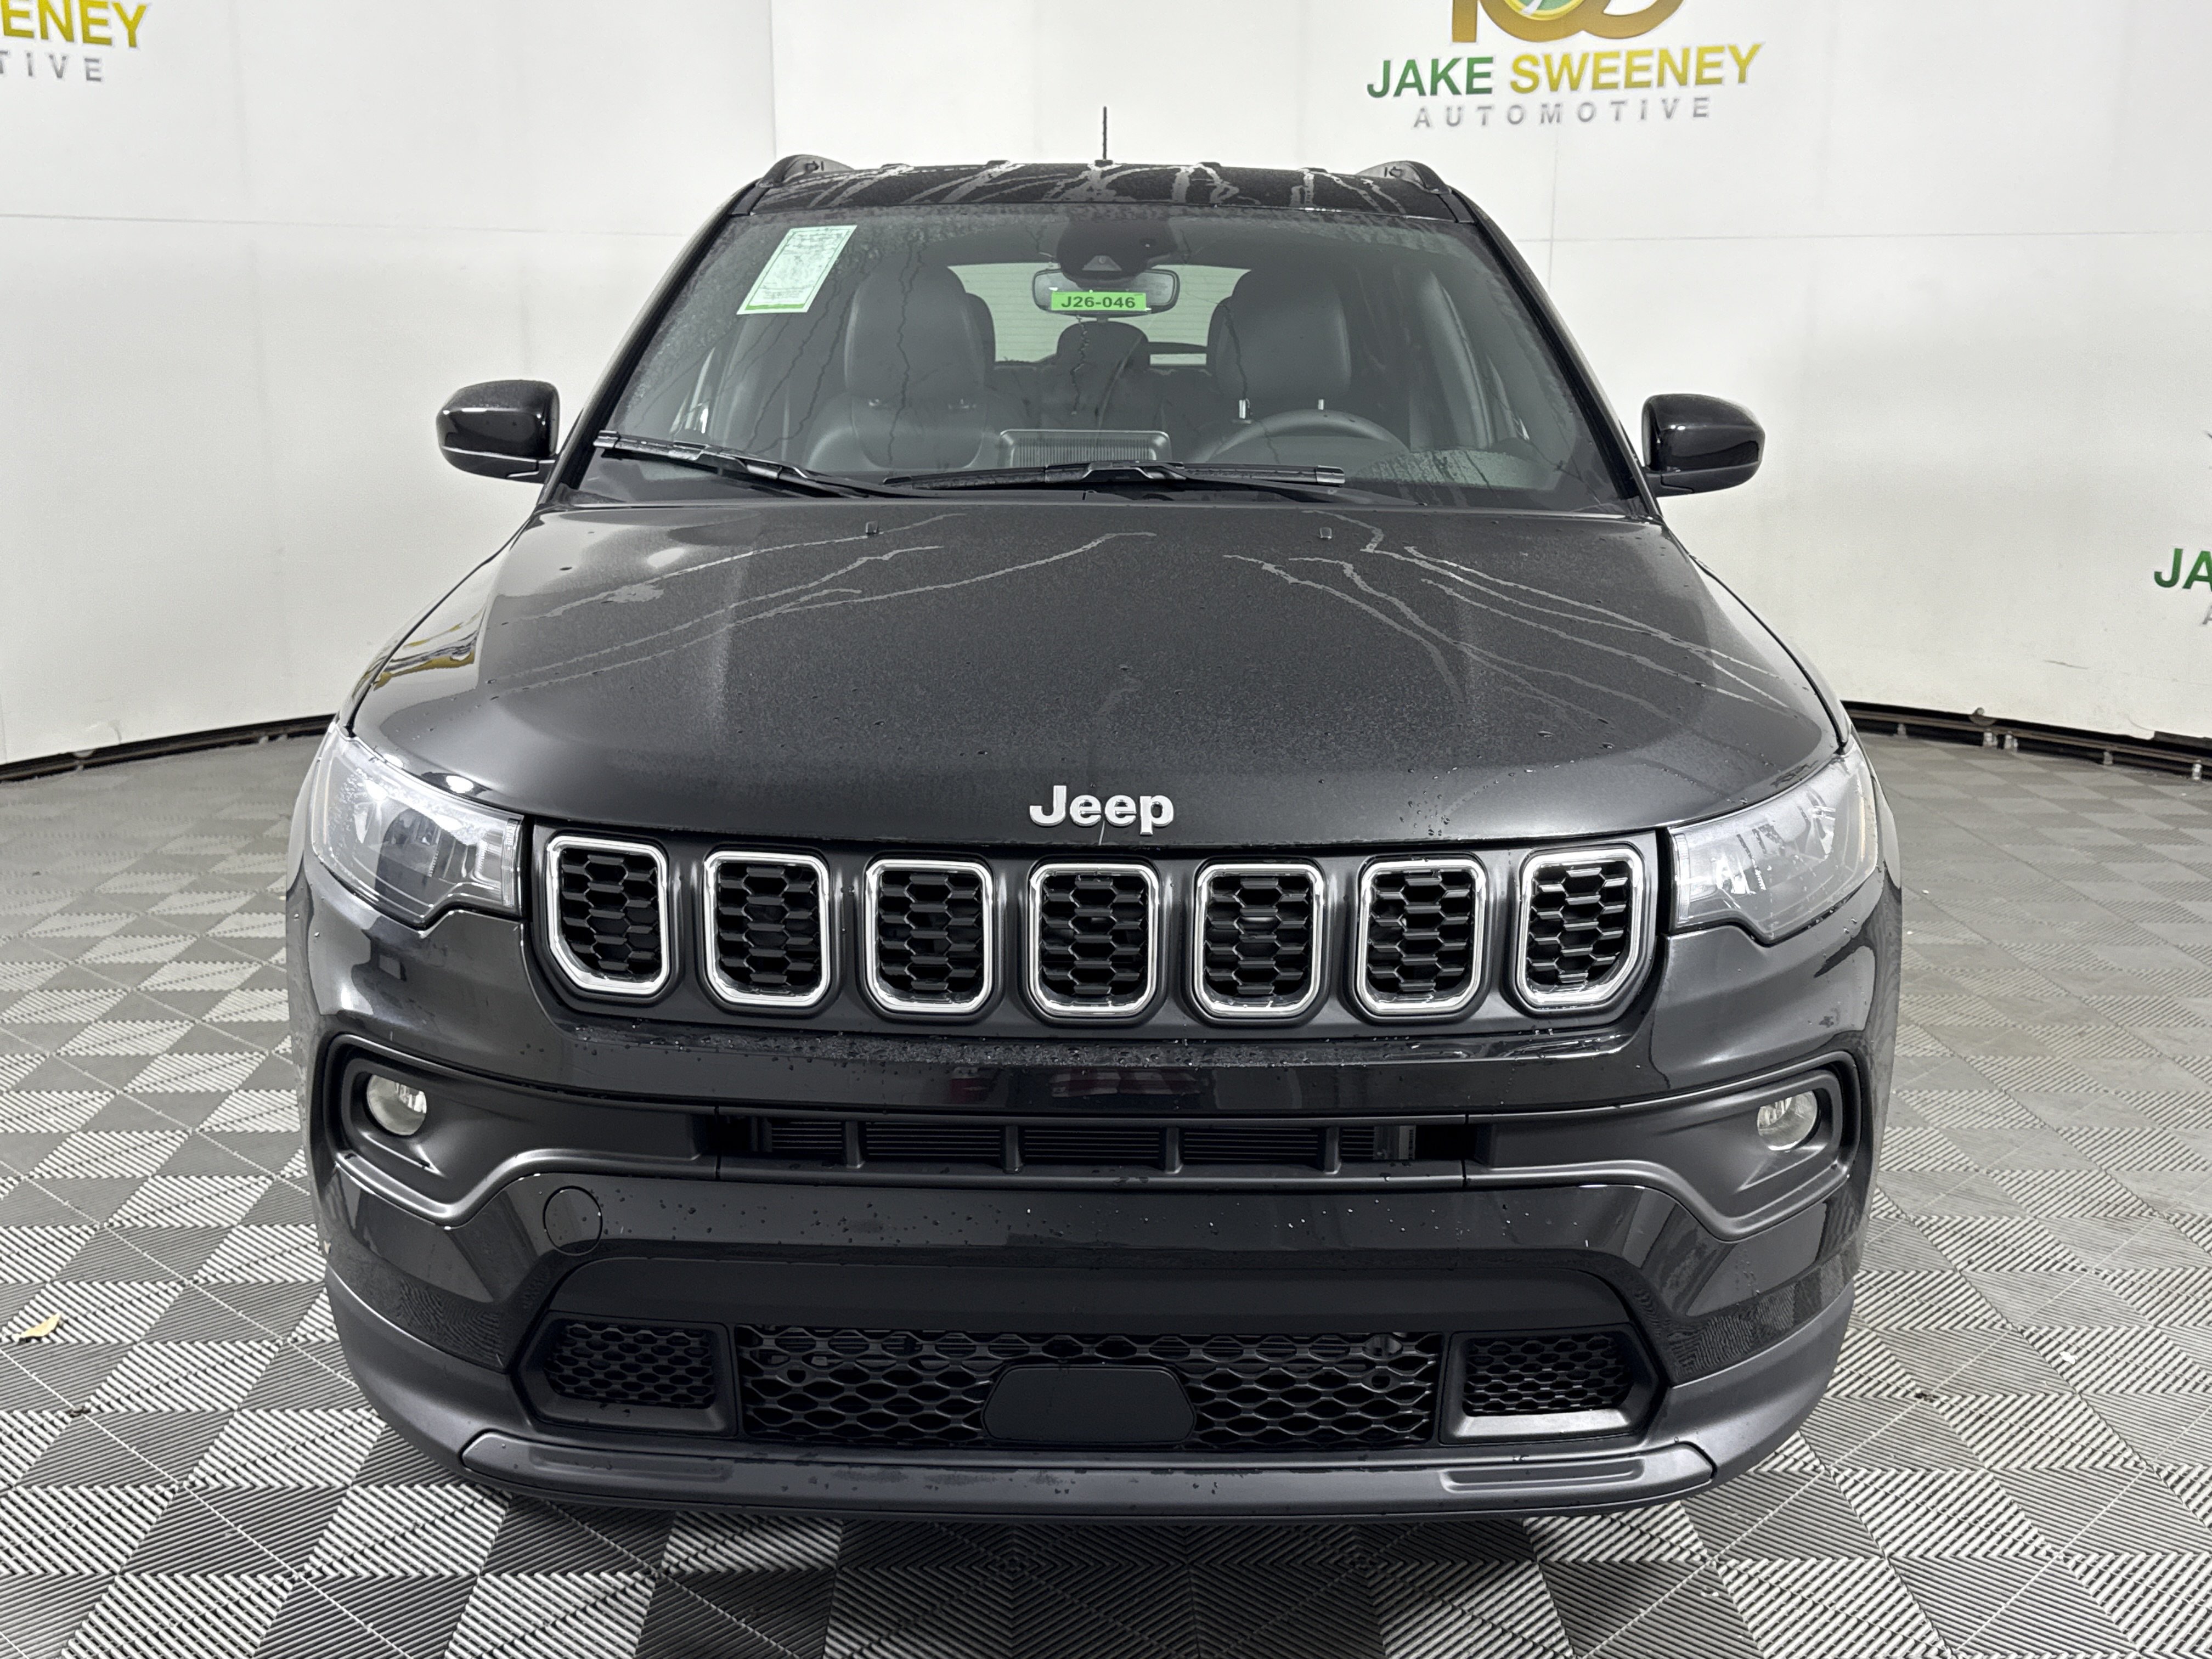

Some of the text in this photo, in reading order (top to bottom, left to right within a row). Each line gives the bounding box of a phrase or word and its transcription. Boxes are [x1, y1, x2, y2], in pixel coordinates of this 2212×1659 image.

[1367, 43, 1763, 98] JAKE SWEENEY
[1413, 97, 1710, 128] AUTOMOTIVE
[1061, 296, 1136, 308] J26-046
[1029, 785, 1174, 835] Jeep
